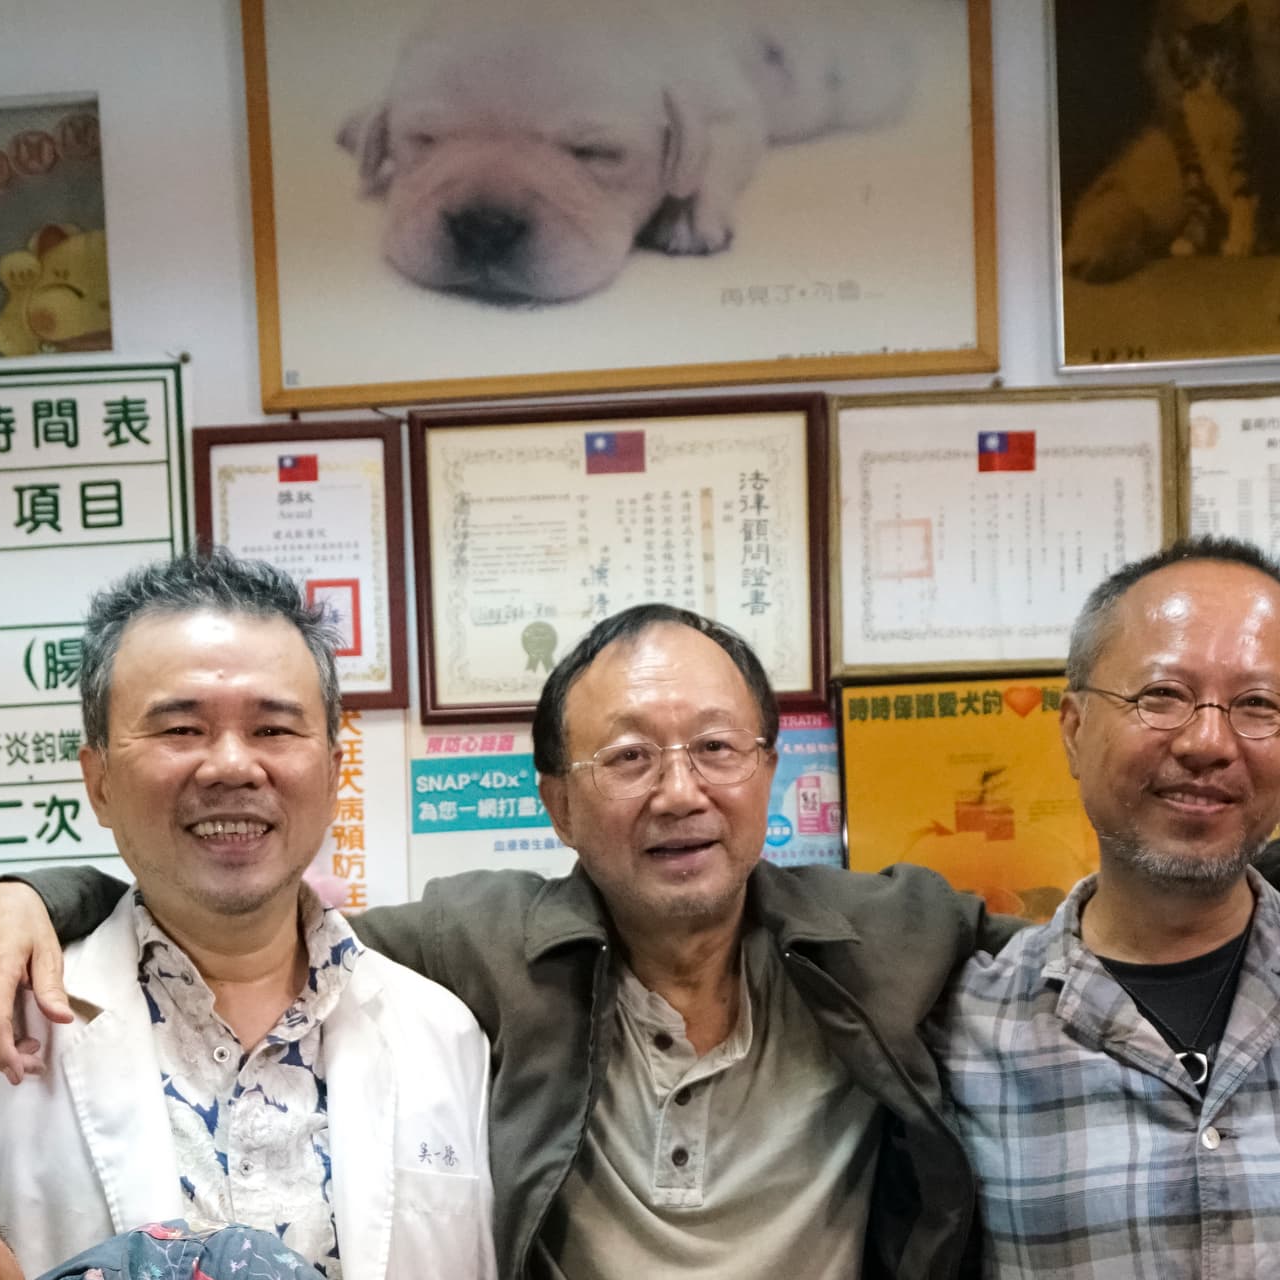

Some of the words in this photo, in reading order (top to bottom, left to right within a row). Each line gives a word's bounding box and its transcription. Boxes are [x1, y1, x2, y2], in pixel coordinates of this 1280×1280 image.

[738, 469, 772, 617] 法律顧問證書
